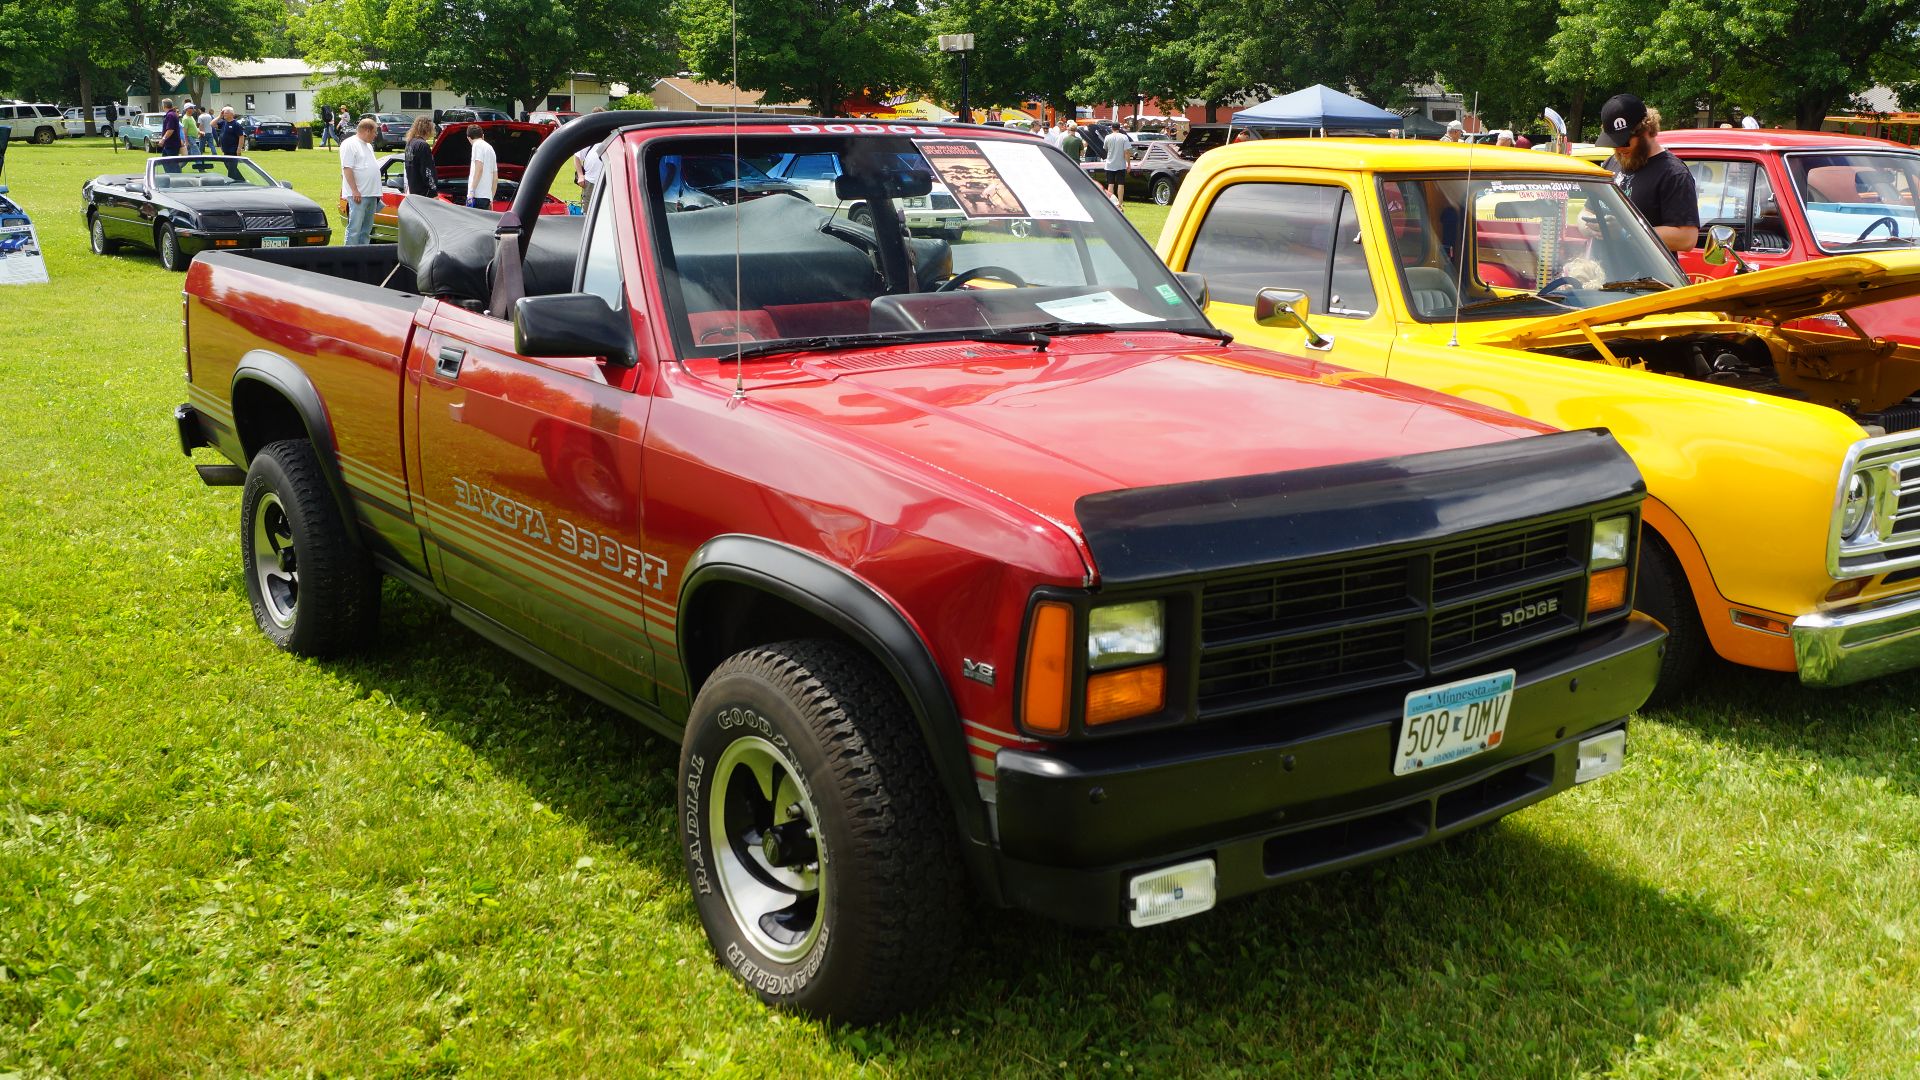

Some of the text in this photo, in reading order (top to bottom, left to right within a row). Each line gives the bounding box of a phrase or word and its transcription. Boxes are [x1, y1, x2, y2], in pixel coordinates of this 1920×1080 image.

[788, 124, 945, 135] DODGE
[1492, 183, 1526, 192] POWER
[451, 476, 668, 591] DAKOTA SPORT
[1501, 598, 1558, 627] DODGE
[963, 657, 993, 679] V6
[1405, 695, 1507, 758] 509 DMV
[686, 754, 712, 896] RADIAL
[726, 922, 830, 995] WRANGLER
